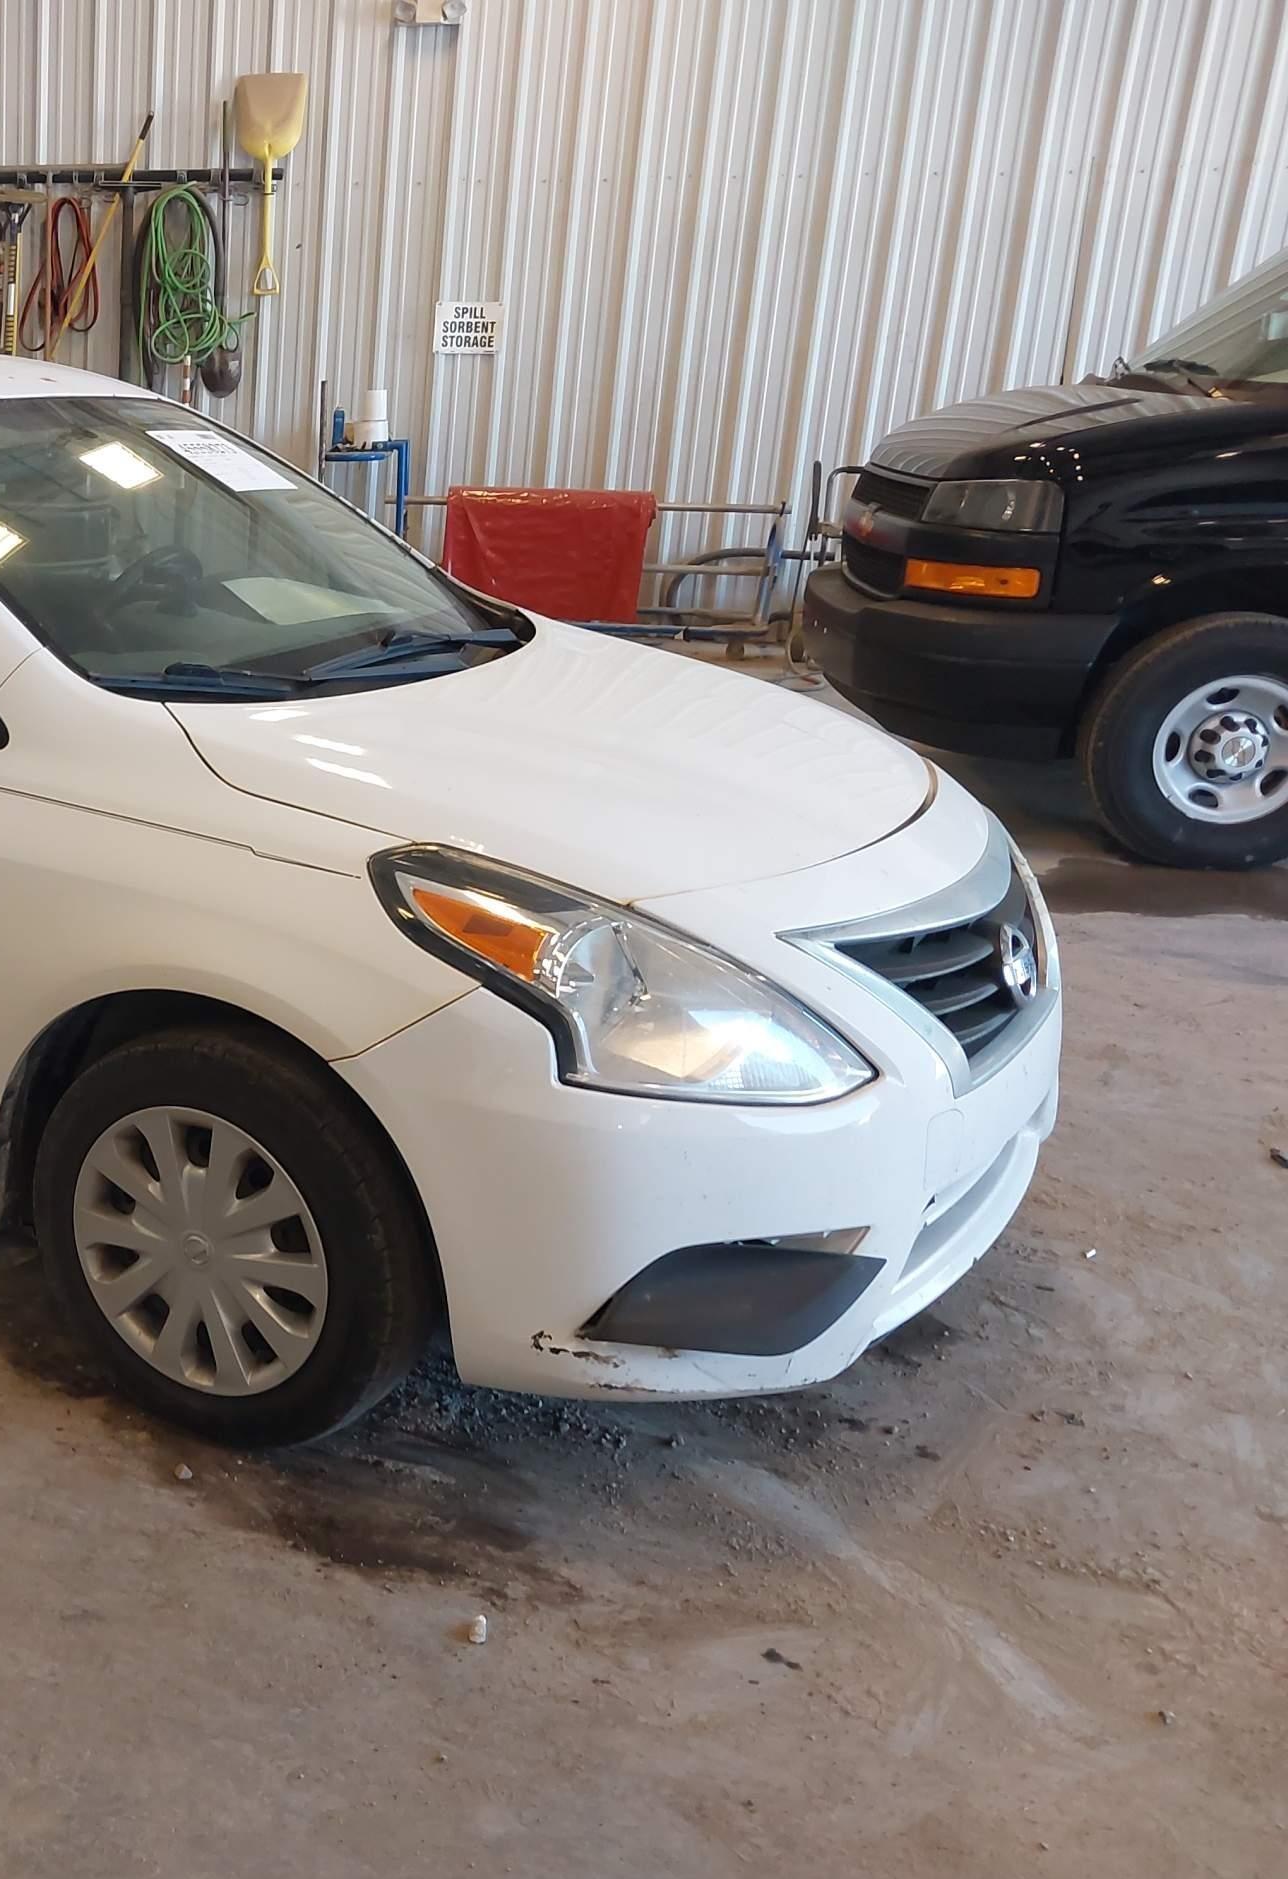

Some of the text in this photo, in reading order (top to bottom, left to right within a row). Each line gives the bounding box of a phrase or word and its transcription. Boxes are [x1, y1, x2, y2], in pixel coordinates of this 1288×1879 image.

[453, 306, 486, 319] SPILL
[442, 320, 497, 334] SORBENT
[441, 335, 495, 348] STORAGE
